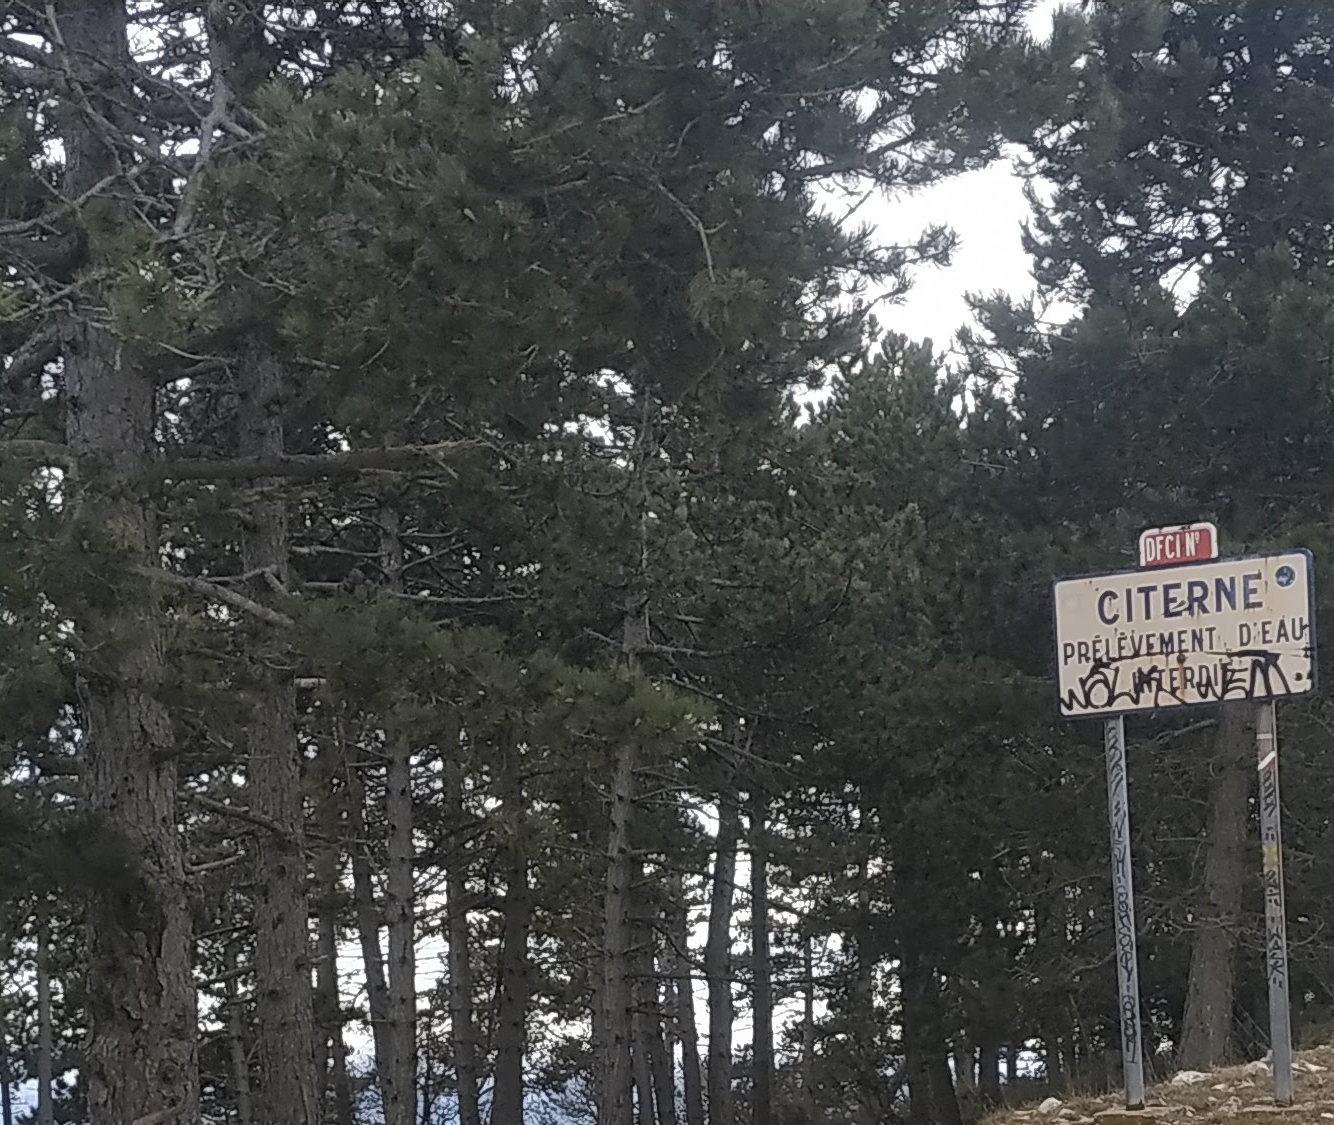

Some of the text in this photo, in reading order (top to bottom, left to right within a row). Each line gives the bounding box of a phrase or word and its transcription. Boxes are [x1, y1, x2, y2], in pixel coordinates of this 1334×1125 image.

[1145, 534, 1181, 562] DFCI
[1097, 571, 1264, 626] CITERNE
[1238, 616, 1305, 648] D'EAU
